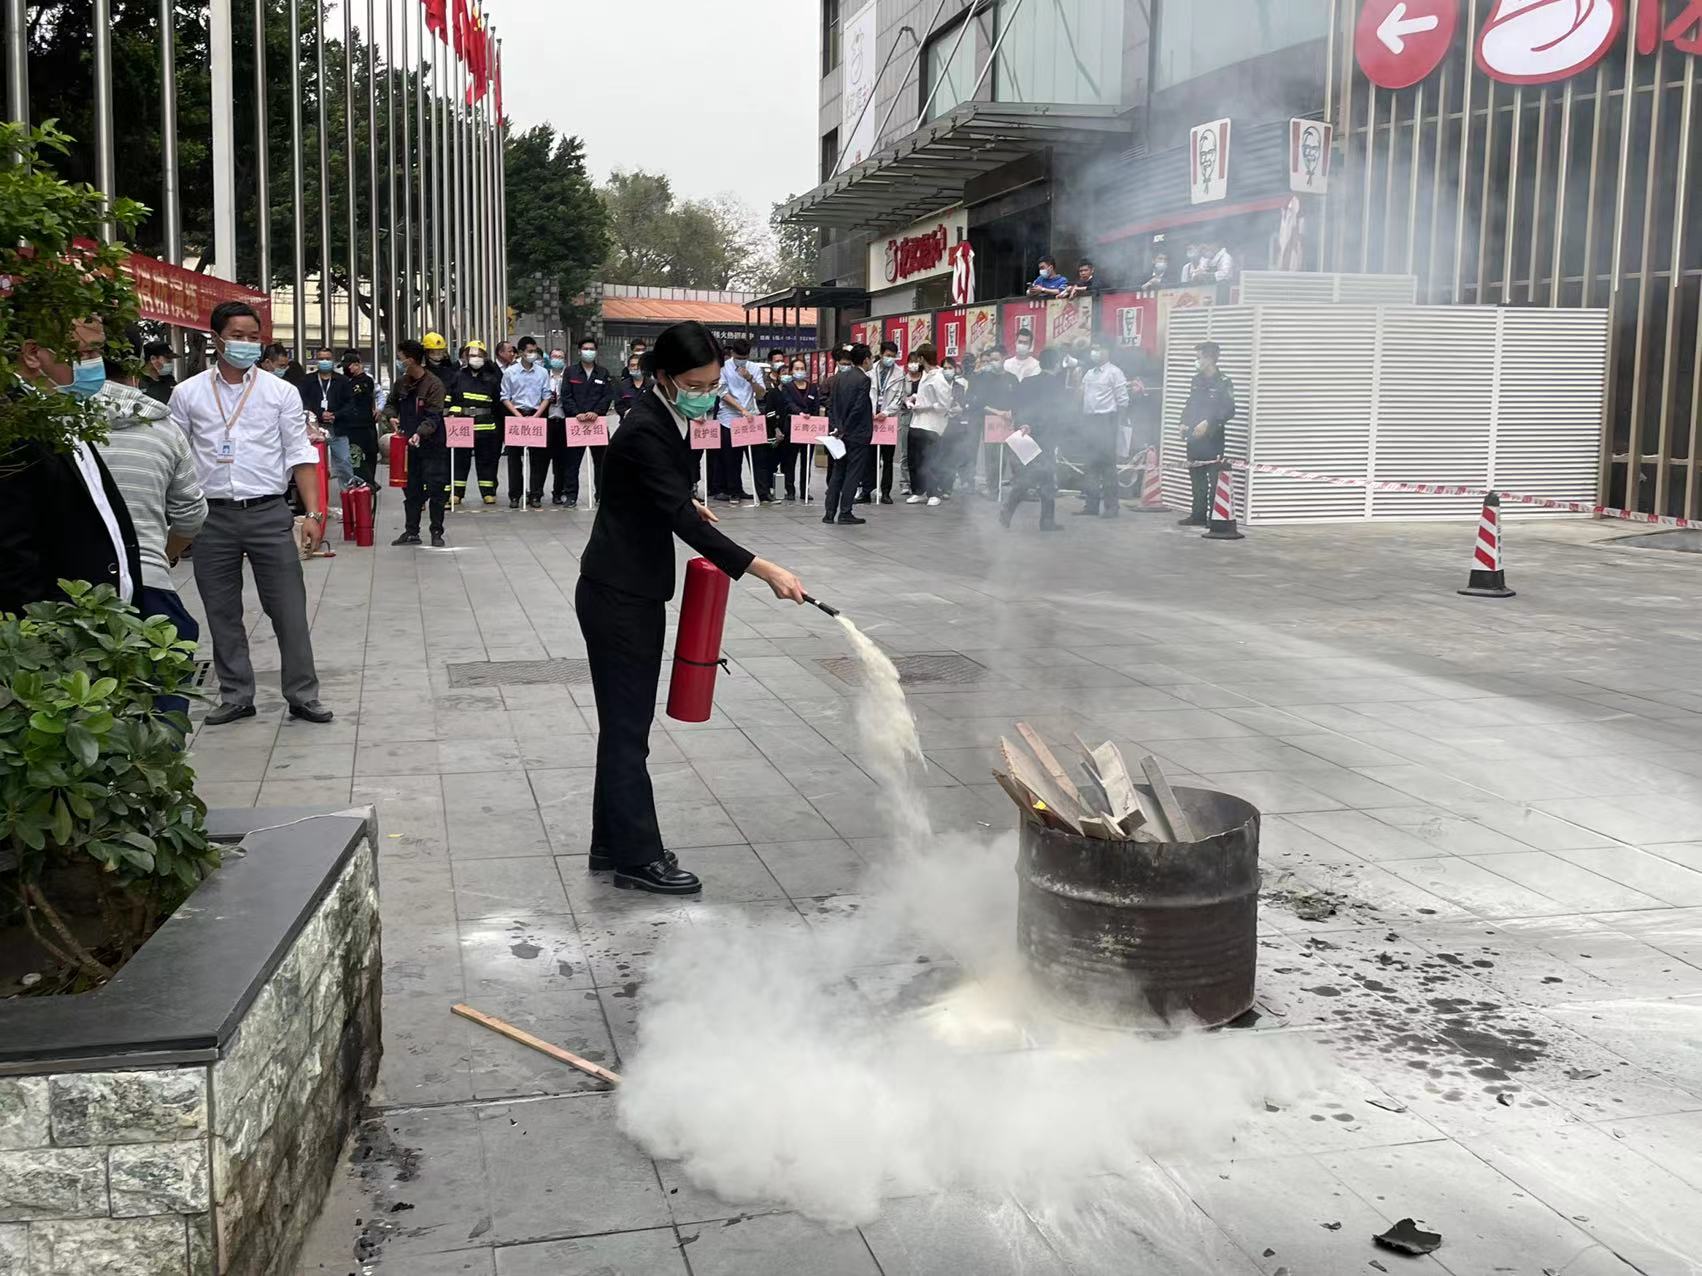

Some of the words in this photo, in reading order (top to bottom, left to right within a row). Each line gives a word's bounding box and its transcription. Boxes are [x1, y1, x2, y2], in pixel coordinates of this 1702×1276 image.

[508, 424, 543, 436] 疏散组
[570, 424, 604, 436] 设备组
